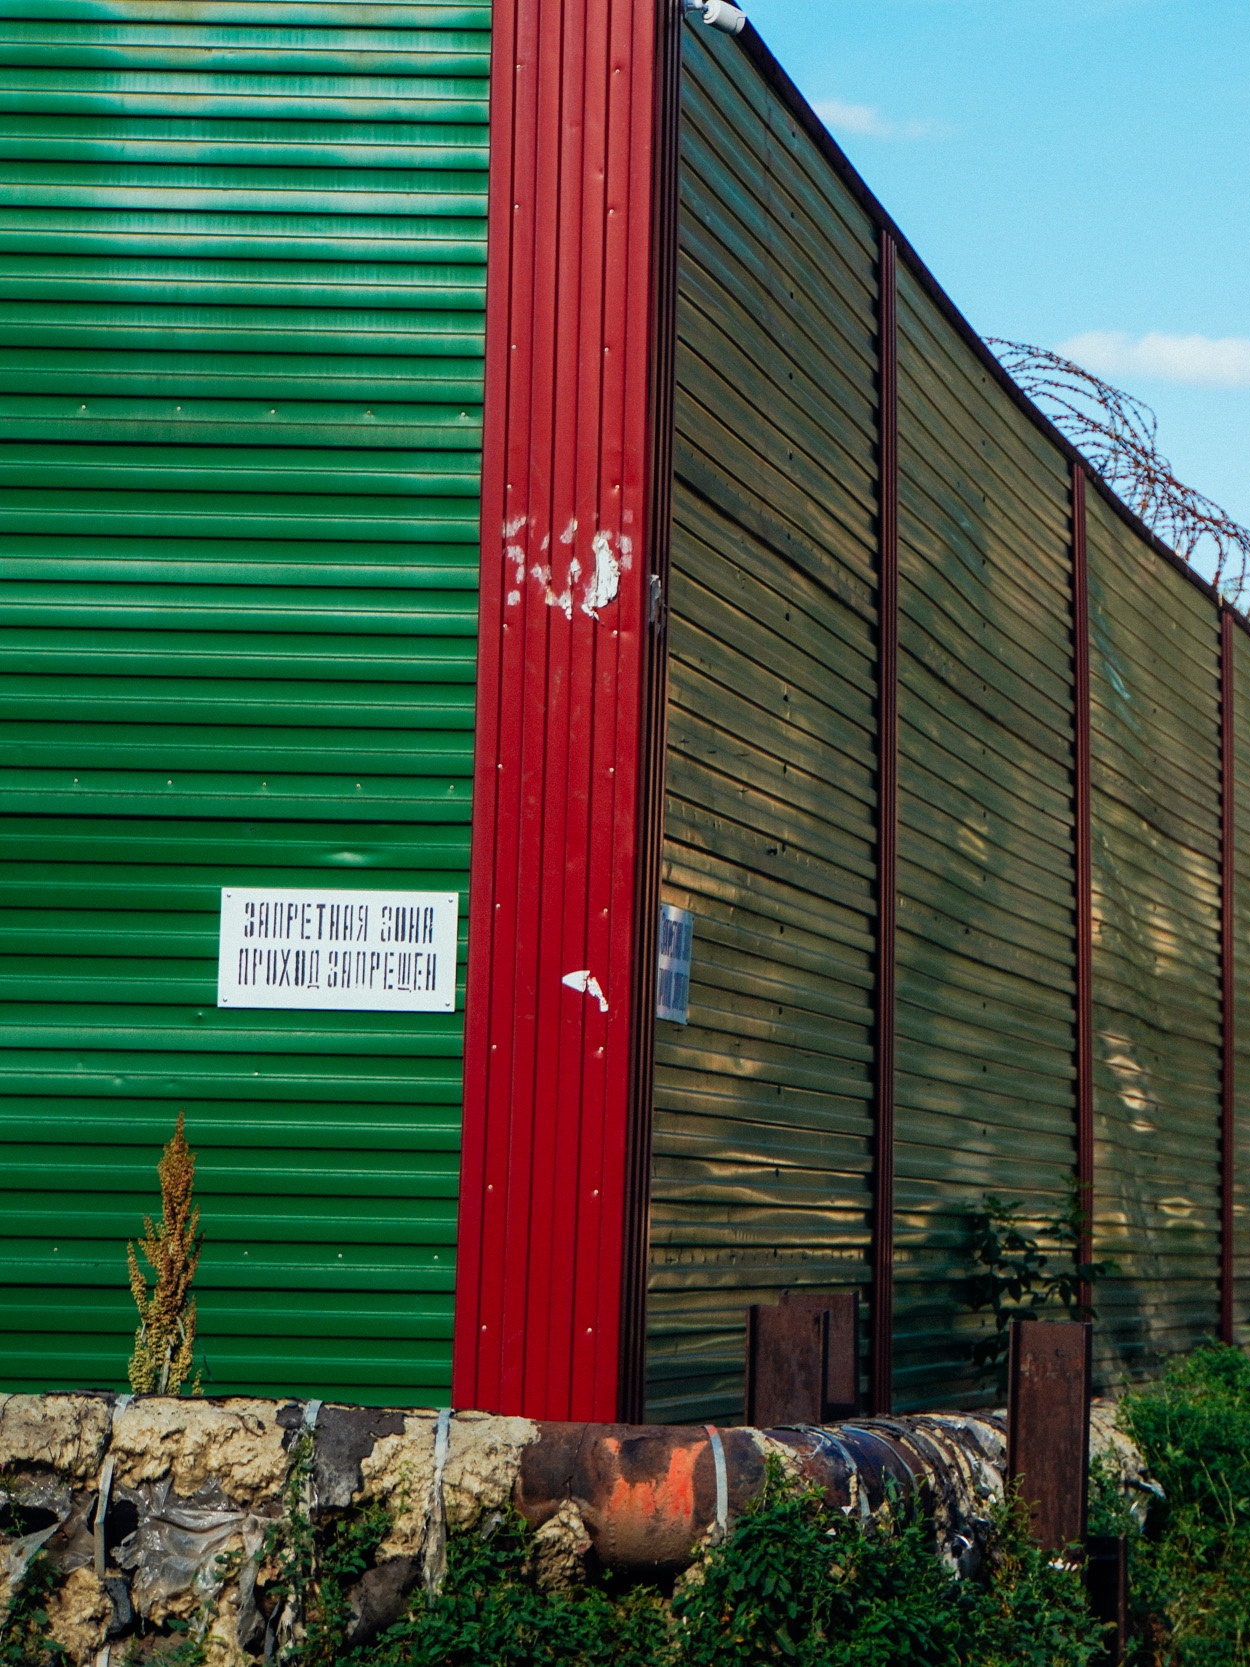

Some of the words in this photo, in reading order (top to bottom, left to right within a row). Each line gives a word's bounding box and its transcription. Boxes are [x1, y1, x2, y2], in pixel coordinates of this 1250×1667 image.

[244, 902, 368, 942] ЗАПРЕТНАЯ
[380, 905, 434, 944] ЗОНА
[327, 950, 437, 993] ЗАПРЕЩЕН
